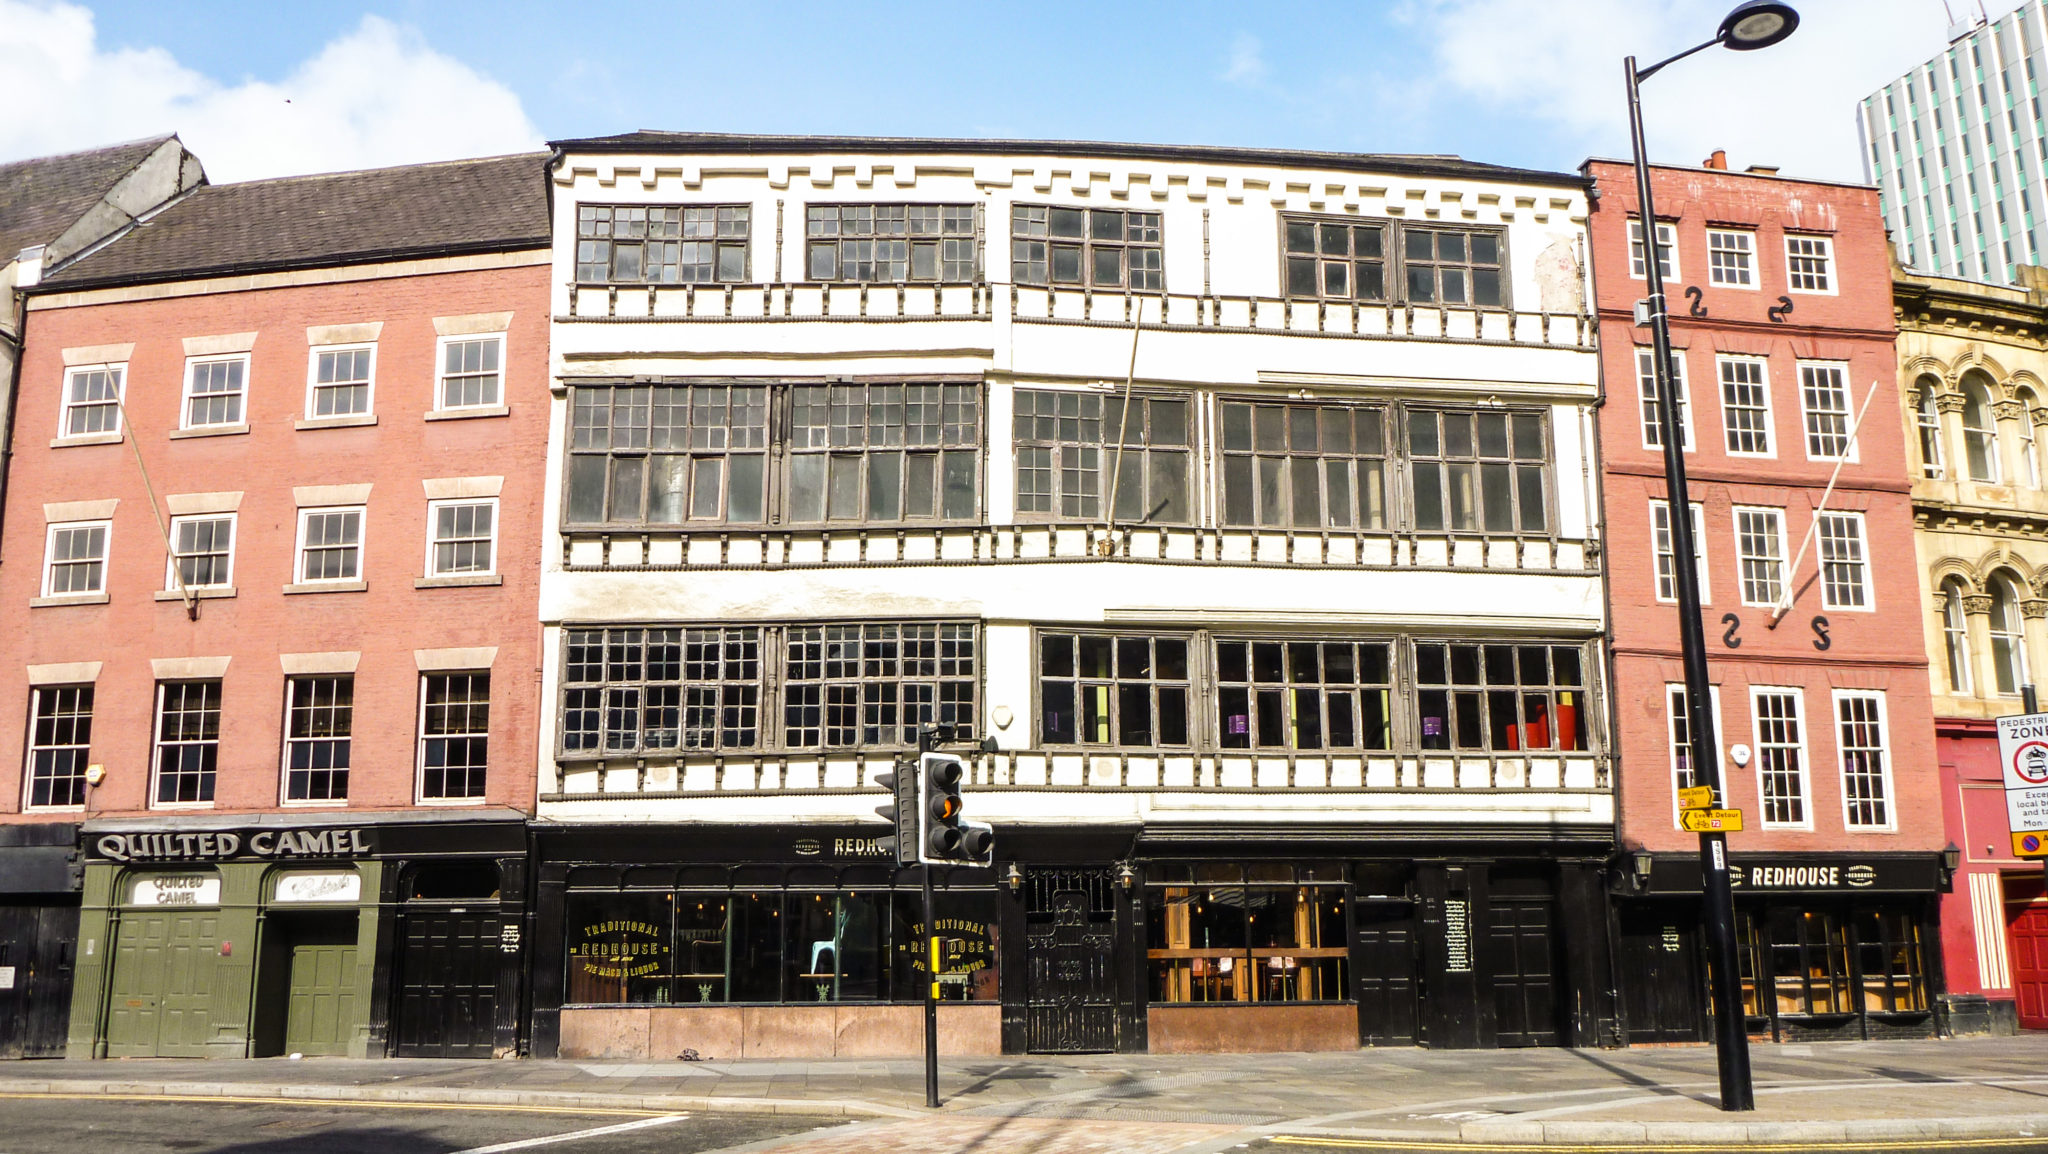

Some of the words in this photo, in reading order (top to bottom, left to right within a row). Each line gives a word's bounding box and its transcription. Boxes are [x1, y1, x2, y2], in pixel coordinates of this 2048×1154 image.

[2017, 800, 2038, 808] local
[98, 833, 239, 861] QUILTED
[251, 829, 370, 855] CAMEL
[153, 875, 204, 891] QUILTED
[1752, 867, 1839, 886] REDHOUSE
[156, 891, 197, 904] CAMEL
[584, 920, 659, 936] TRADITIONAL
[912, 919, 984, 935] TRDITIONAL
[581, 943, 658, 955] REDHOUSE
[910, 941, 984, 953] REOUSE
[584, 963, 598, 974] PIE
[630, 961, 659, 976] LIQUOR
[912, 960, 925, 971] PIE
